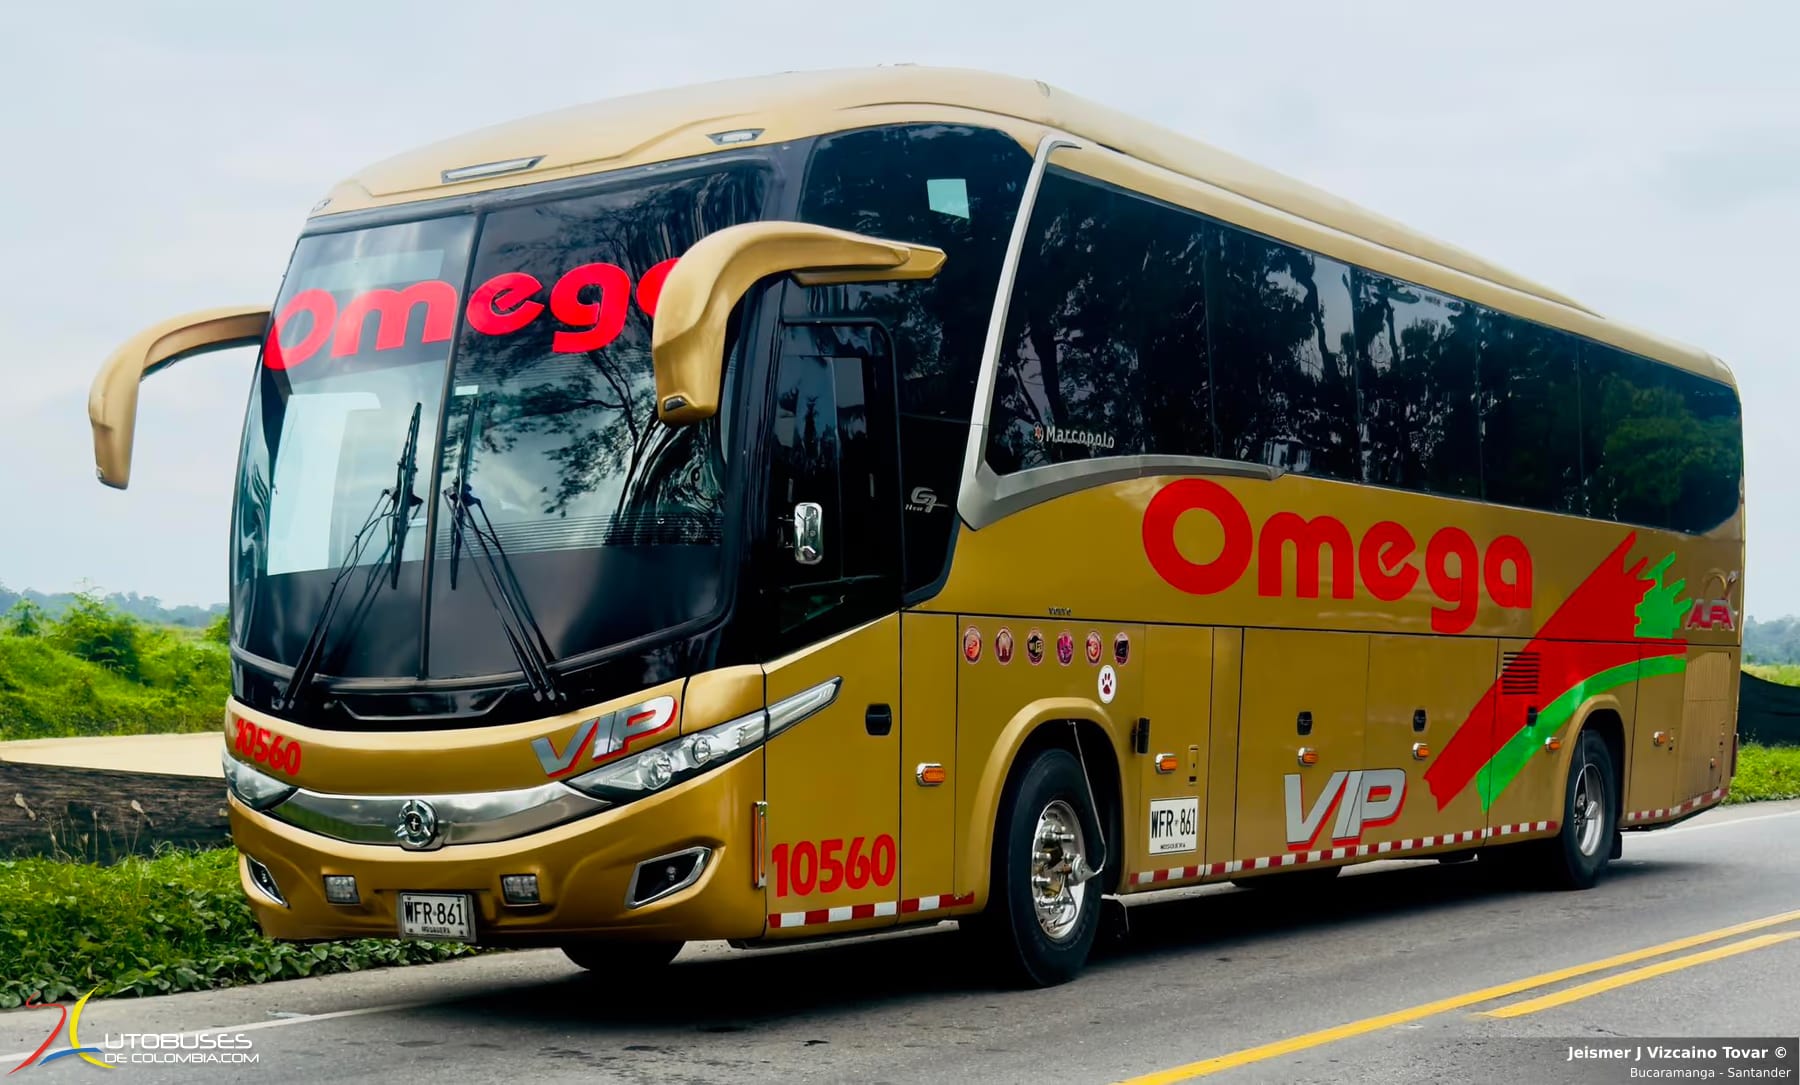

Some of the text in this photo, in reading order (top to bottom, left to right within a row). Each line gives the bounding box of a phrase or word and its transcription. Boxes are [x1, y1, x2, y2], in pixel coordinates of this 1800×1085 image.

[1046, 425, 1115, 449] Marcopolo
[1142, 478, 1533, 634] Omega
[235, 717, 302, 777] 10560
[531, 696, 678, 778] VIP
[1283, 767, 1407, 851] VIP
[771, 833, 896, 897] 10560
